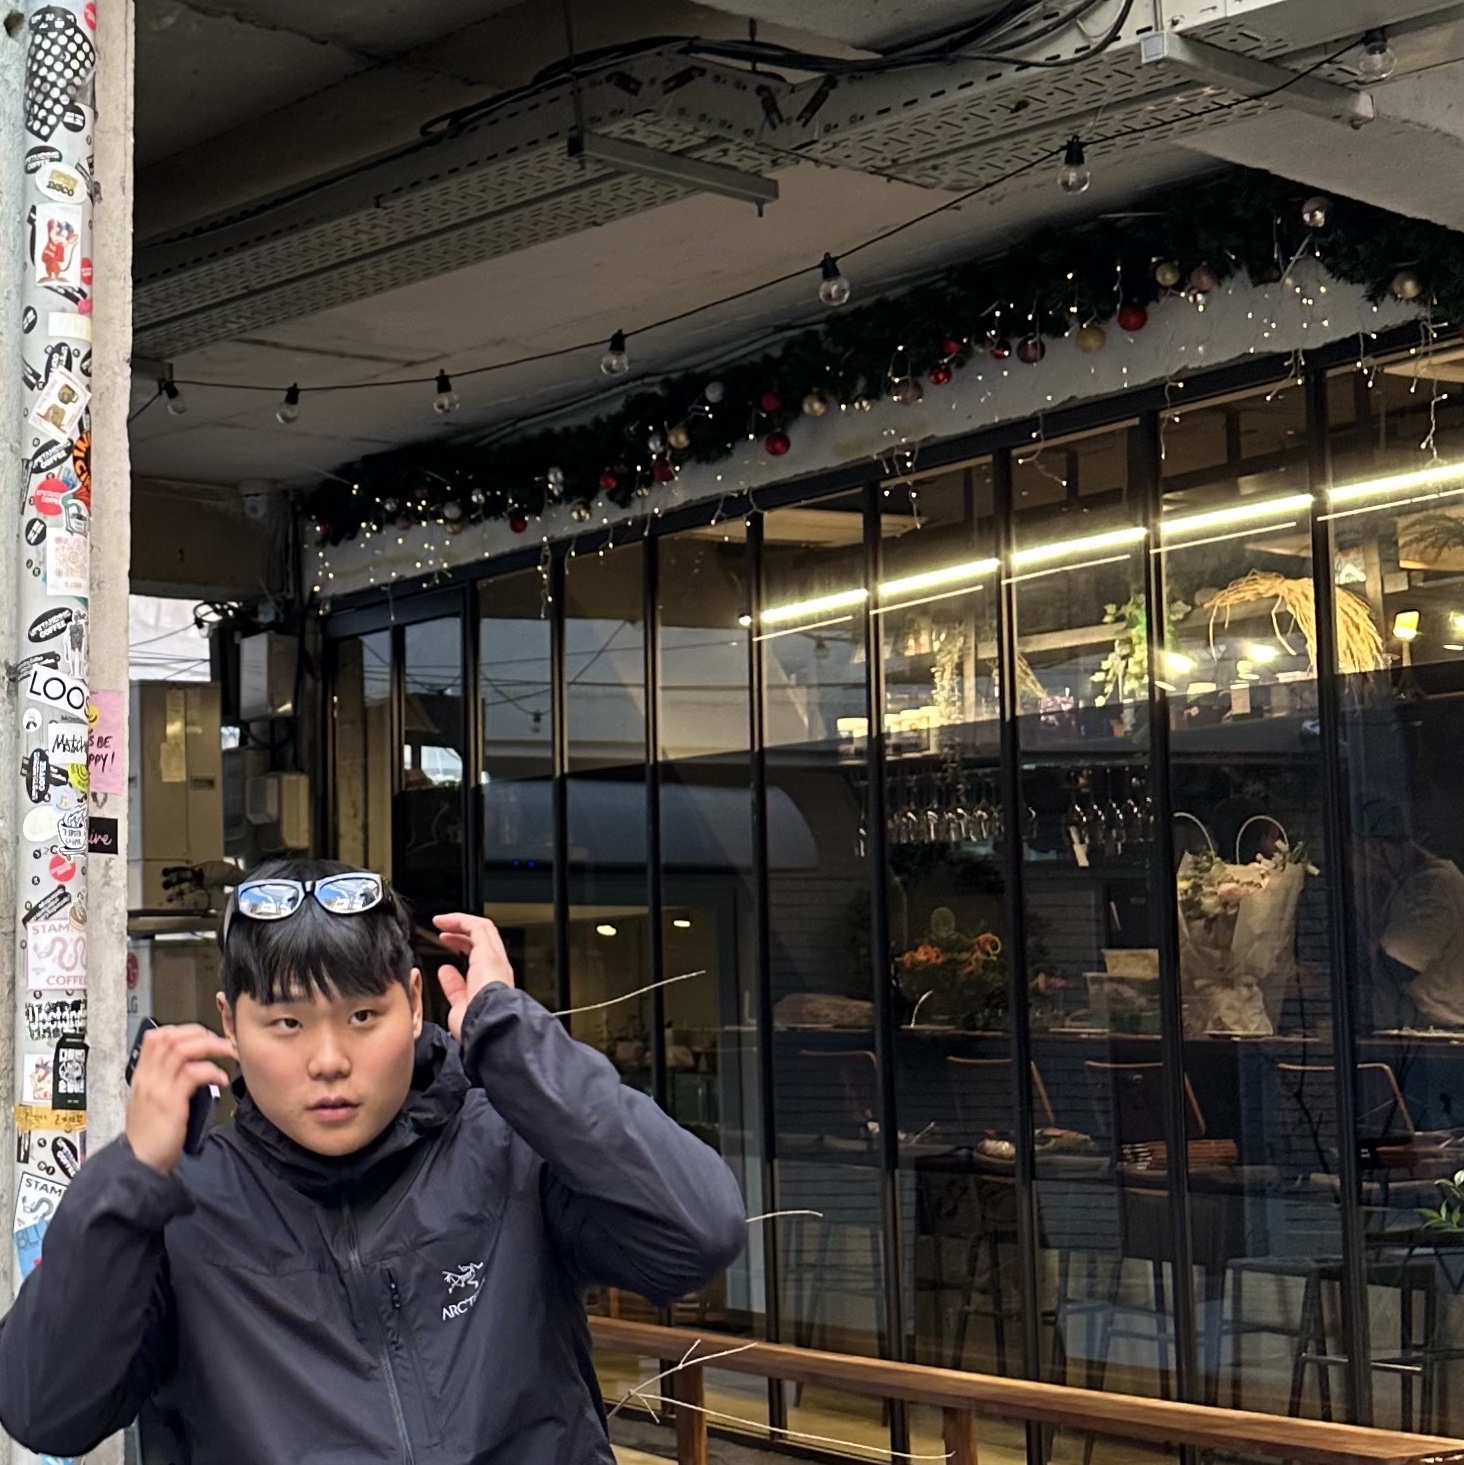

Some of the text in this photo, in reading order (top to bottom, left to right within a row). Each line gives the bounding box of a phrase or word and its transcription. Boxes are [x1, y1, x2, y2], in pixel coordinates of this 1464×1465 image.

[97, 735, 113, 749] BE
[32, 924, 72, 935] STAM
[25, 1178, 63, 1197] STAM
